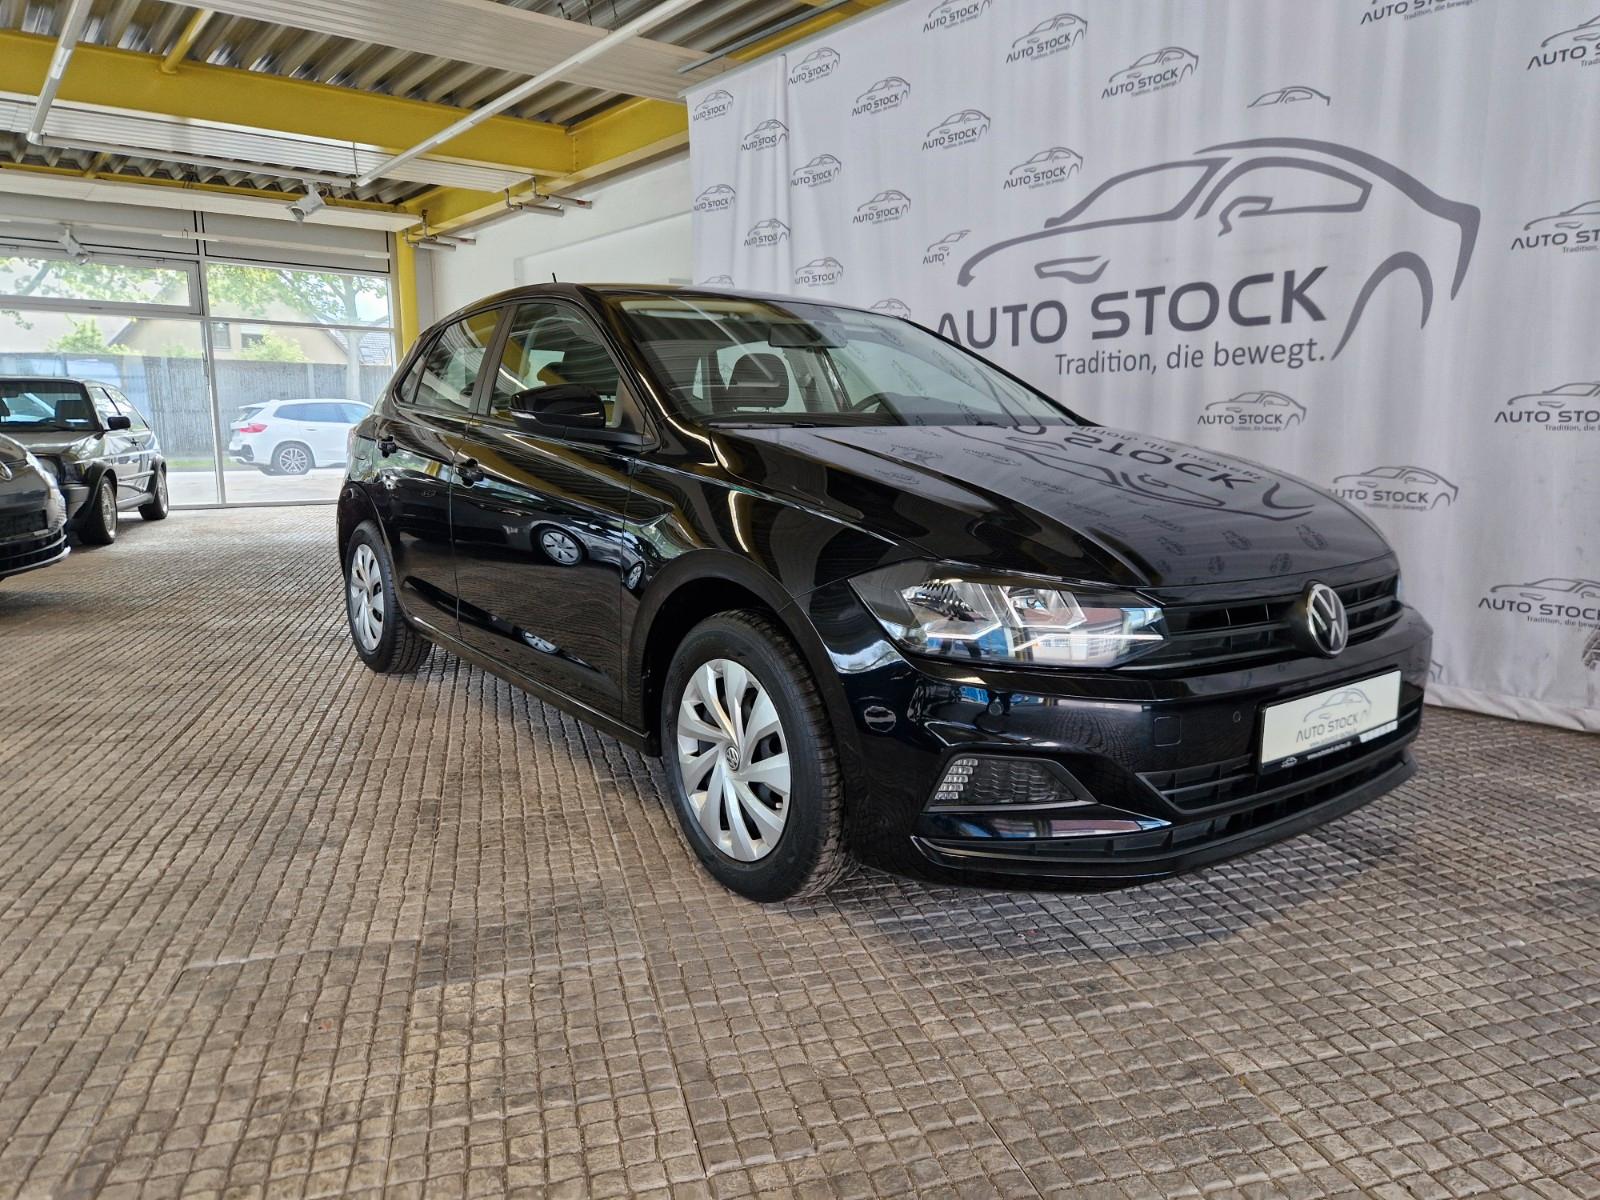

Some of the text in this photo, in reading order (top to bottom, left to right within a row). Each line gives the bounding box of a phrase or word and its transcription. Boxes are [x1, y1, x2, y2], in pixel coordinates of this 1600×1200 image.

[923, 16, 946, 32] AUTO
[949, 3, 979, 21] STOCK
[1360, 1, 1408, 25] AUTO
[1006, 44, 1034, 64] AUTO
[1036, 32, 1071, 53] STOCK
[1527, 46, 1587, 70] AUTO
[788, 73, 806, 86] AUTO
[808, 64, 831, 78] STOCK
[1101, 81, 1134, 99] AUTO
[1138, 67, 1178, 88] STOCK
[852, 103, 872, 116] AUTO
[874, 94, 899, 108] STOCK
[922, 137, 945, 151] AUTO
[948, 127, 977, 142] STOCK
[812, 169, 832, 182] STOCK
[1003, 175, 1031, 190] AUTO
[1033, 165, 1067, 183] STOCK
[853, 213, 874, 224] AUTO
[876, 206, 900, 219] STOCK
[1511, 232, 1568, 250] AUTO
[922, 253, 945, 264] AUTO
[937, 266, 1328, 349] AUTO STOCK
[1055, 338, 1325, 376] Tradition, die bewegt.
[1197, 414, 1283, 425] AUTO STOCK
[1494, 410, 1551, 423] AUTO
[1373, 490, 1429, 503] STOCK
[1478, 597, 1600, 621] AUTO STOC
[1296, 723, 1325, 743] AUTO
[1328, 713, 1358, 733] STOCK
